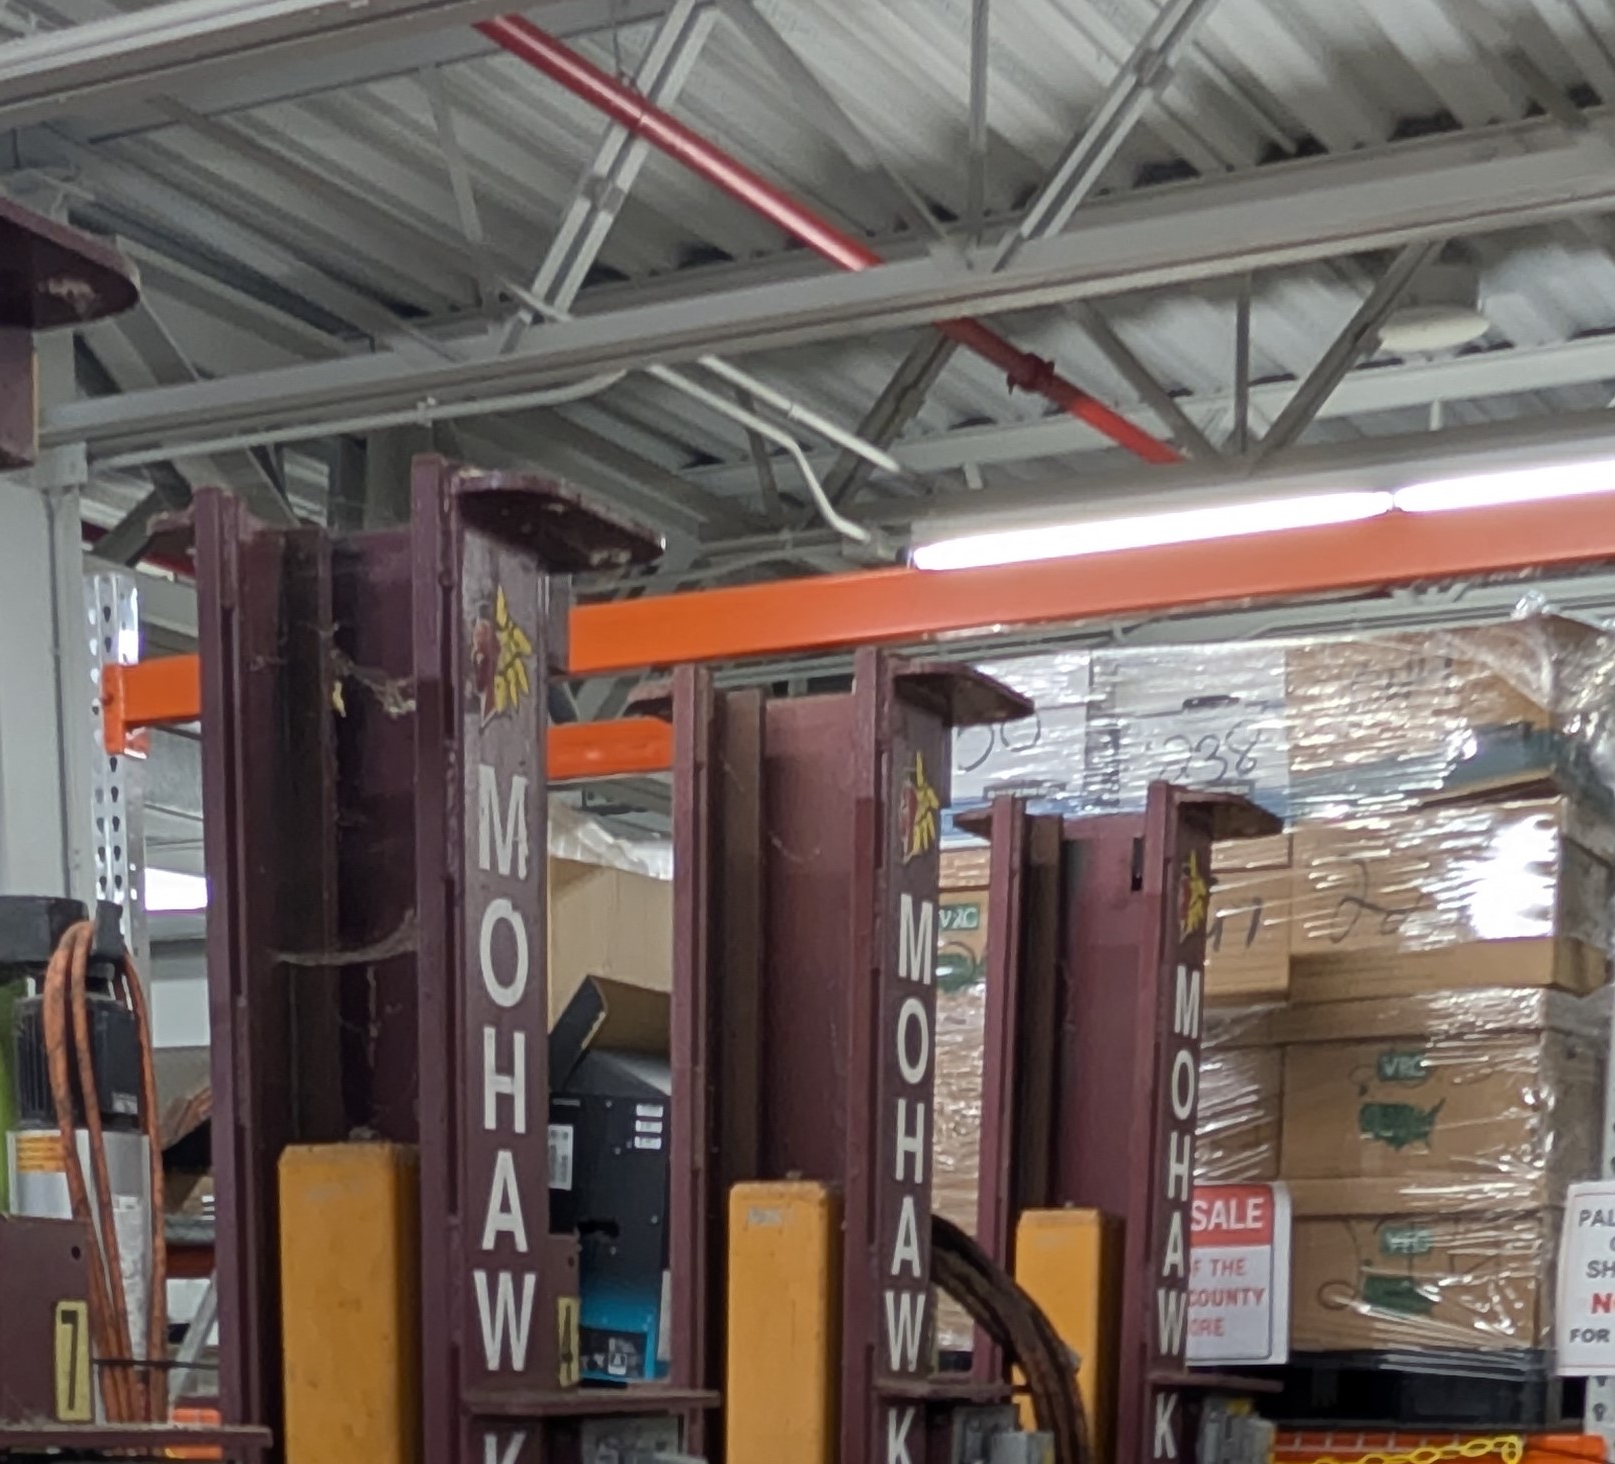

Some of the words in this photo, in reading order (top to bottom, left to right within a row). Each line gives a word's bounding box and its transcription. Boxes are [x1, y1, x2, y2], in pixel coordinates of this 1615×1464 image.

[1153, 963, 1201, 1459] MOHAWK
[1190, 1196, 1265, 1232] SALE
[1210, 1256, 1248, 1277] THE
[1187, 1286, 1265, 1308] COUNTY
[1569, 1328, 1610, 1344] FOR
